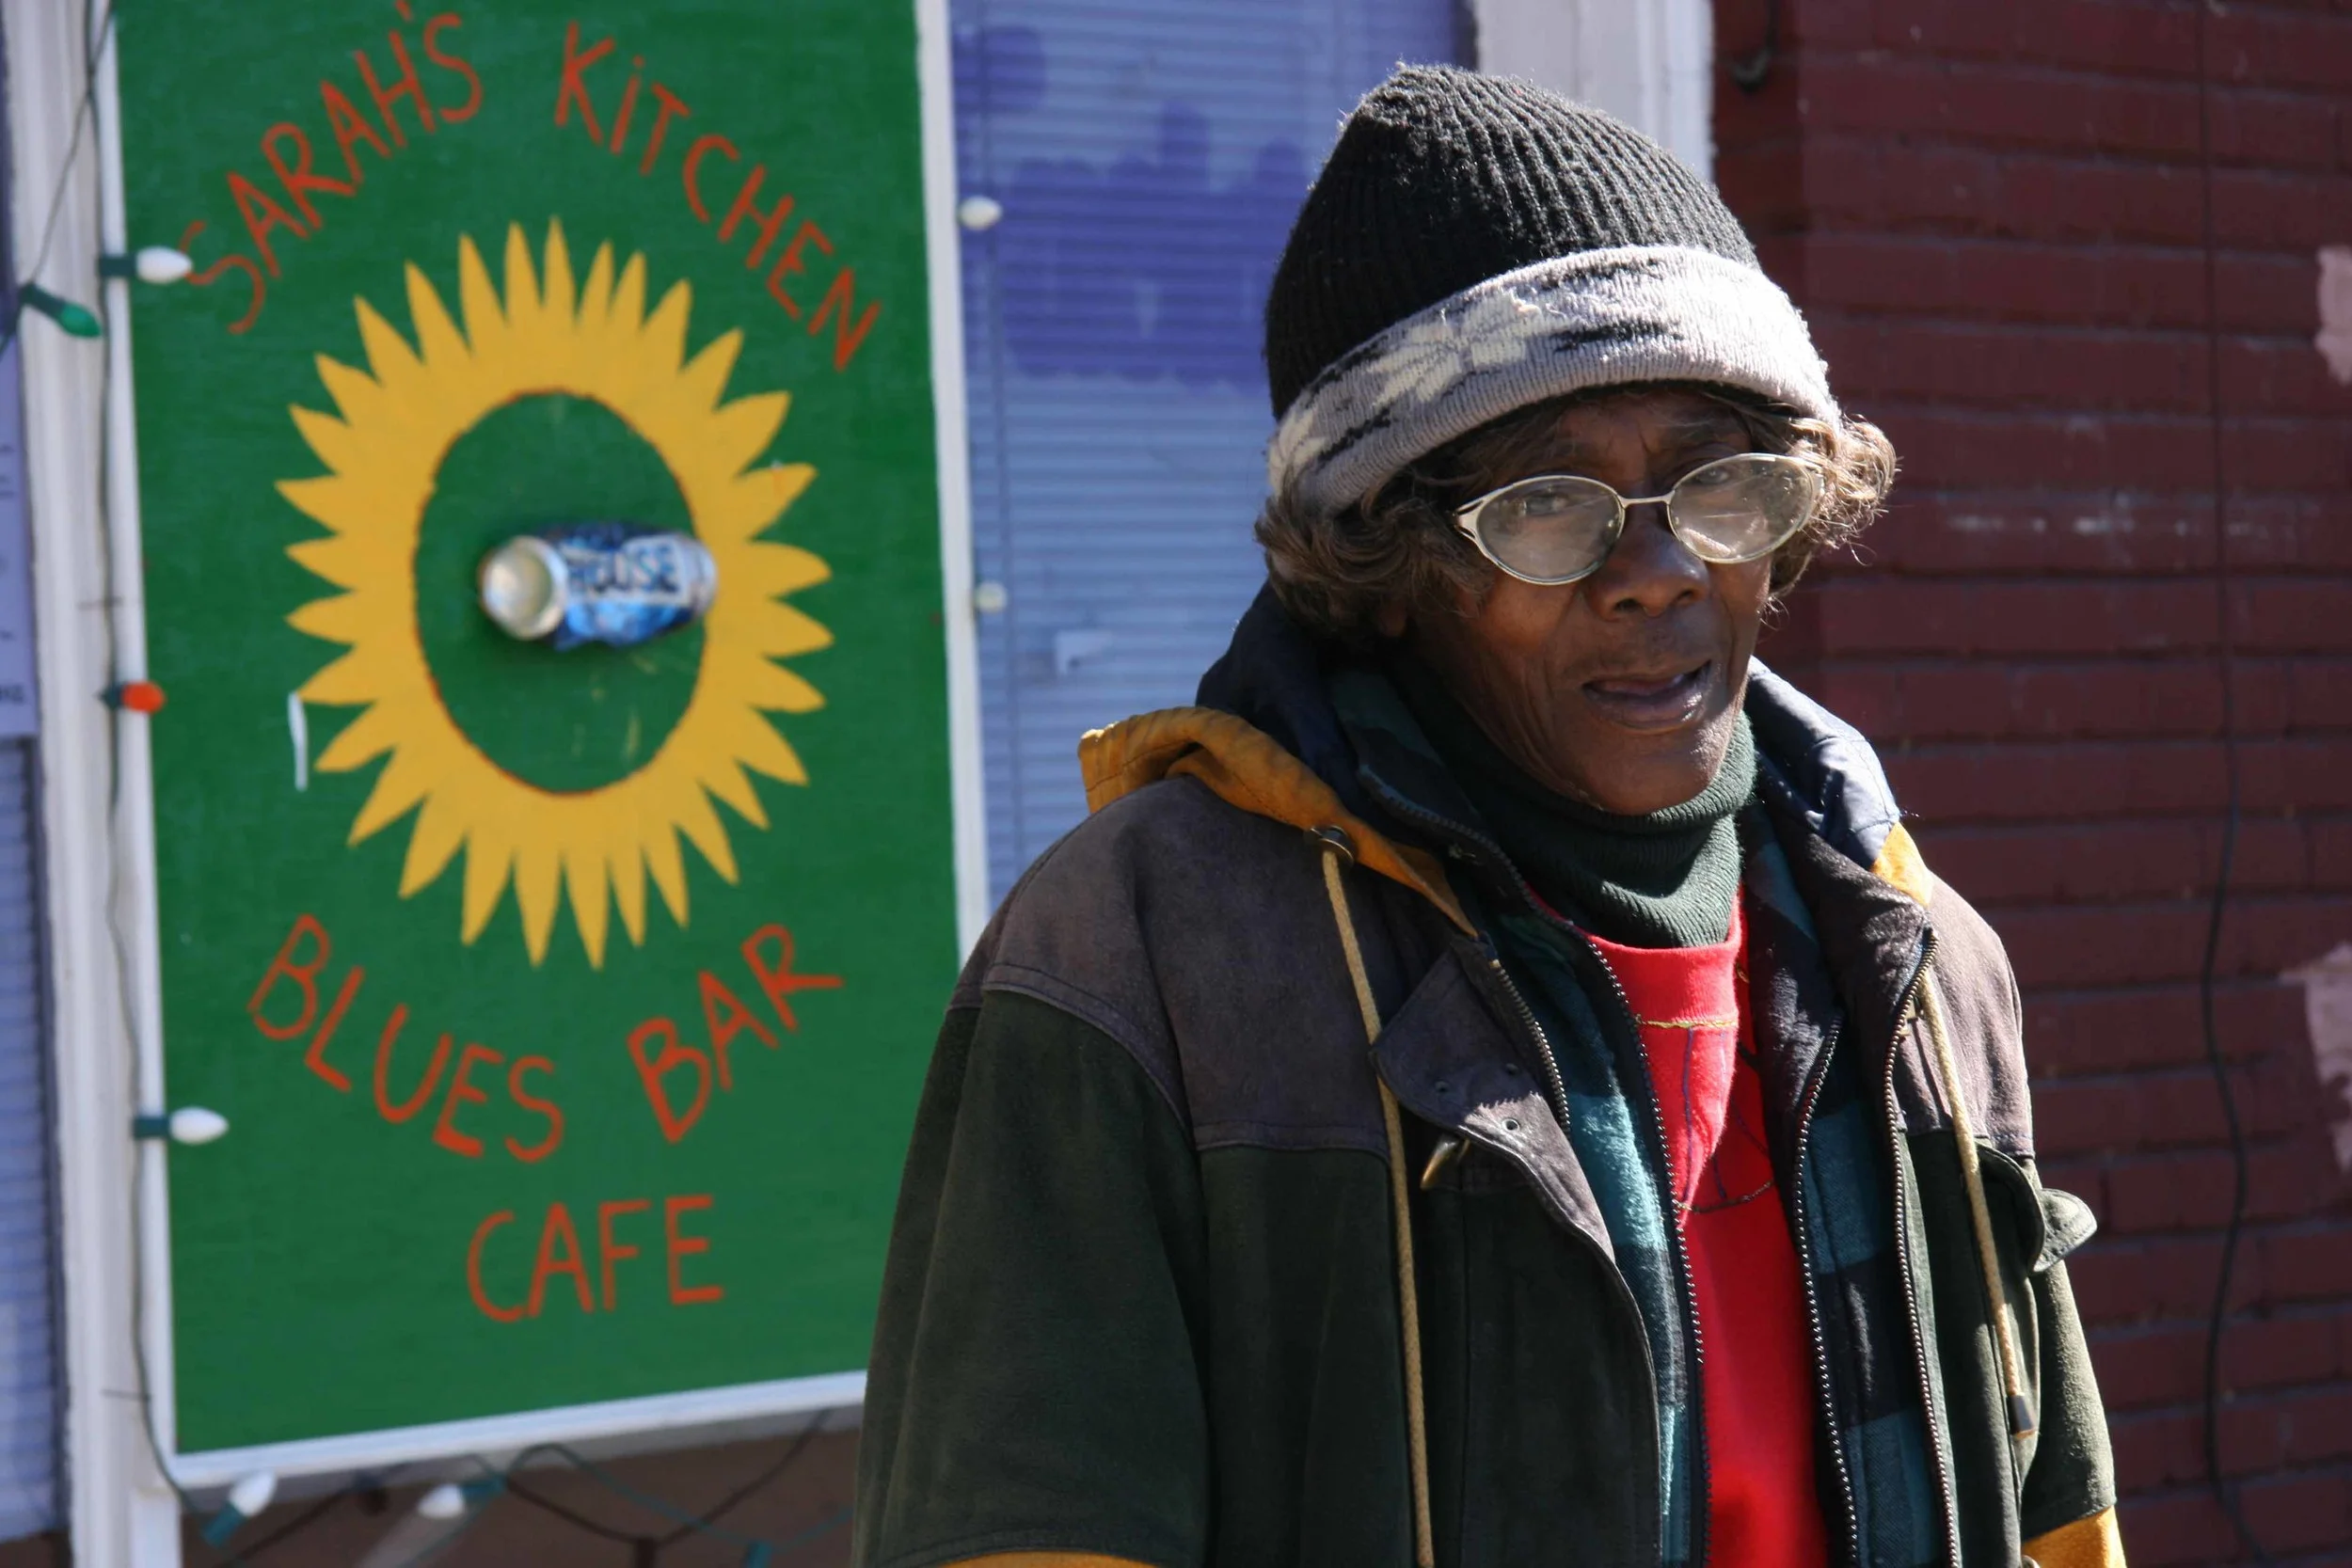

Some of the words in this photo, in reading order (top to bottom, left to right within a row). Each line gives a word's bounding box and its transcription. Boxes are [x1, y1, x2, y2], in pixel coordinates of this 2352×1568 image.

[179, 0, 482, 334] SARAH'S
[247, 913, 564, 1163] BLUES
[626, 924, 843, 1143] BAR
[467, 1194, 723, 1323] CAFE
